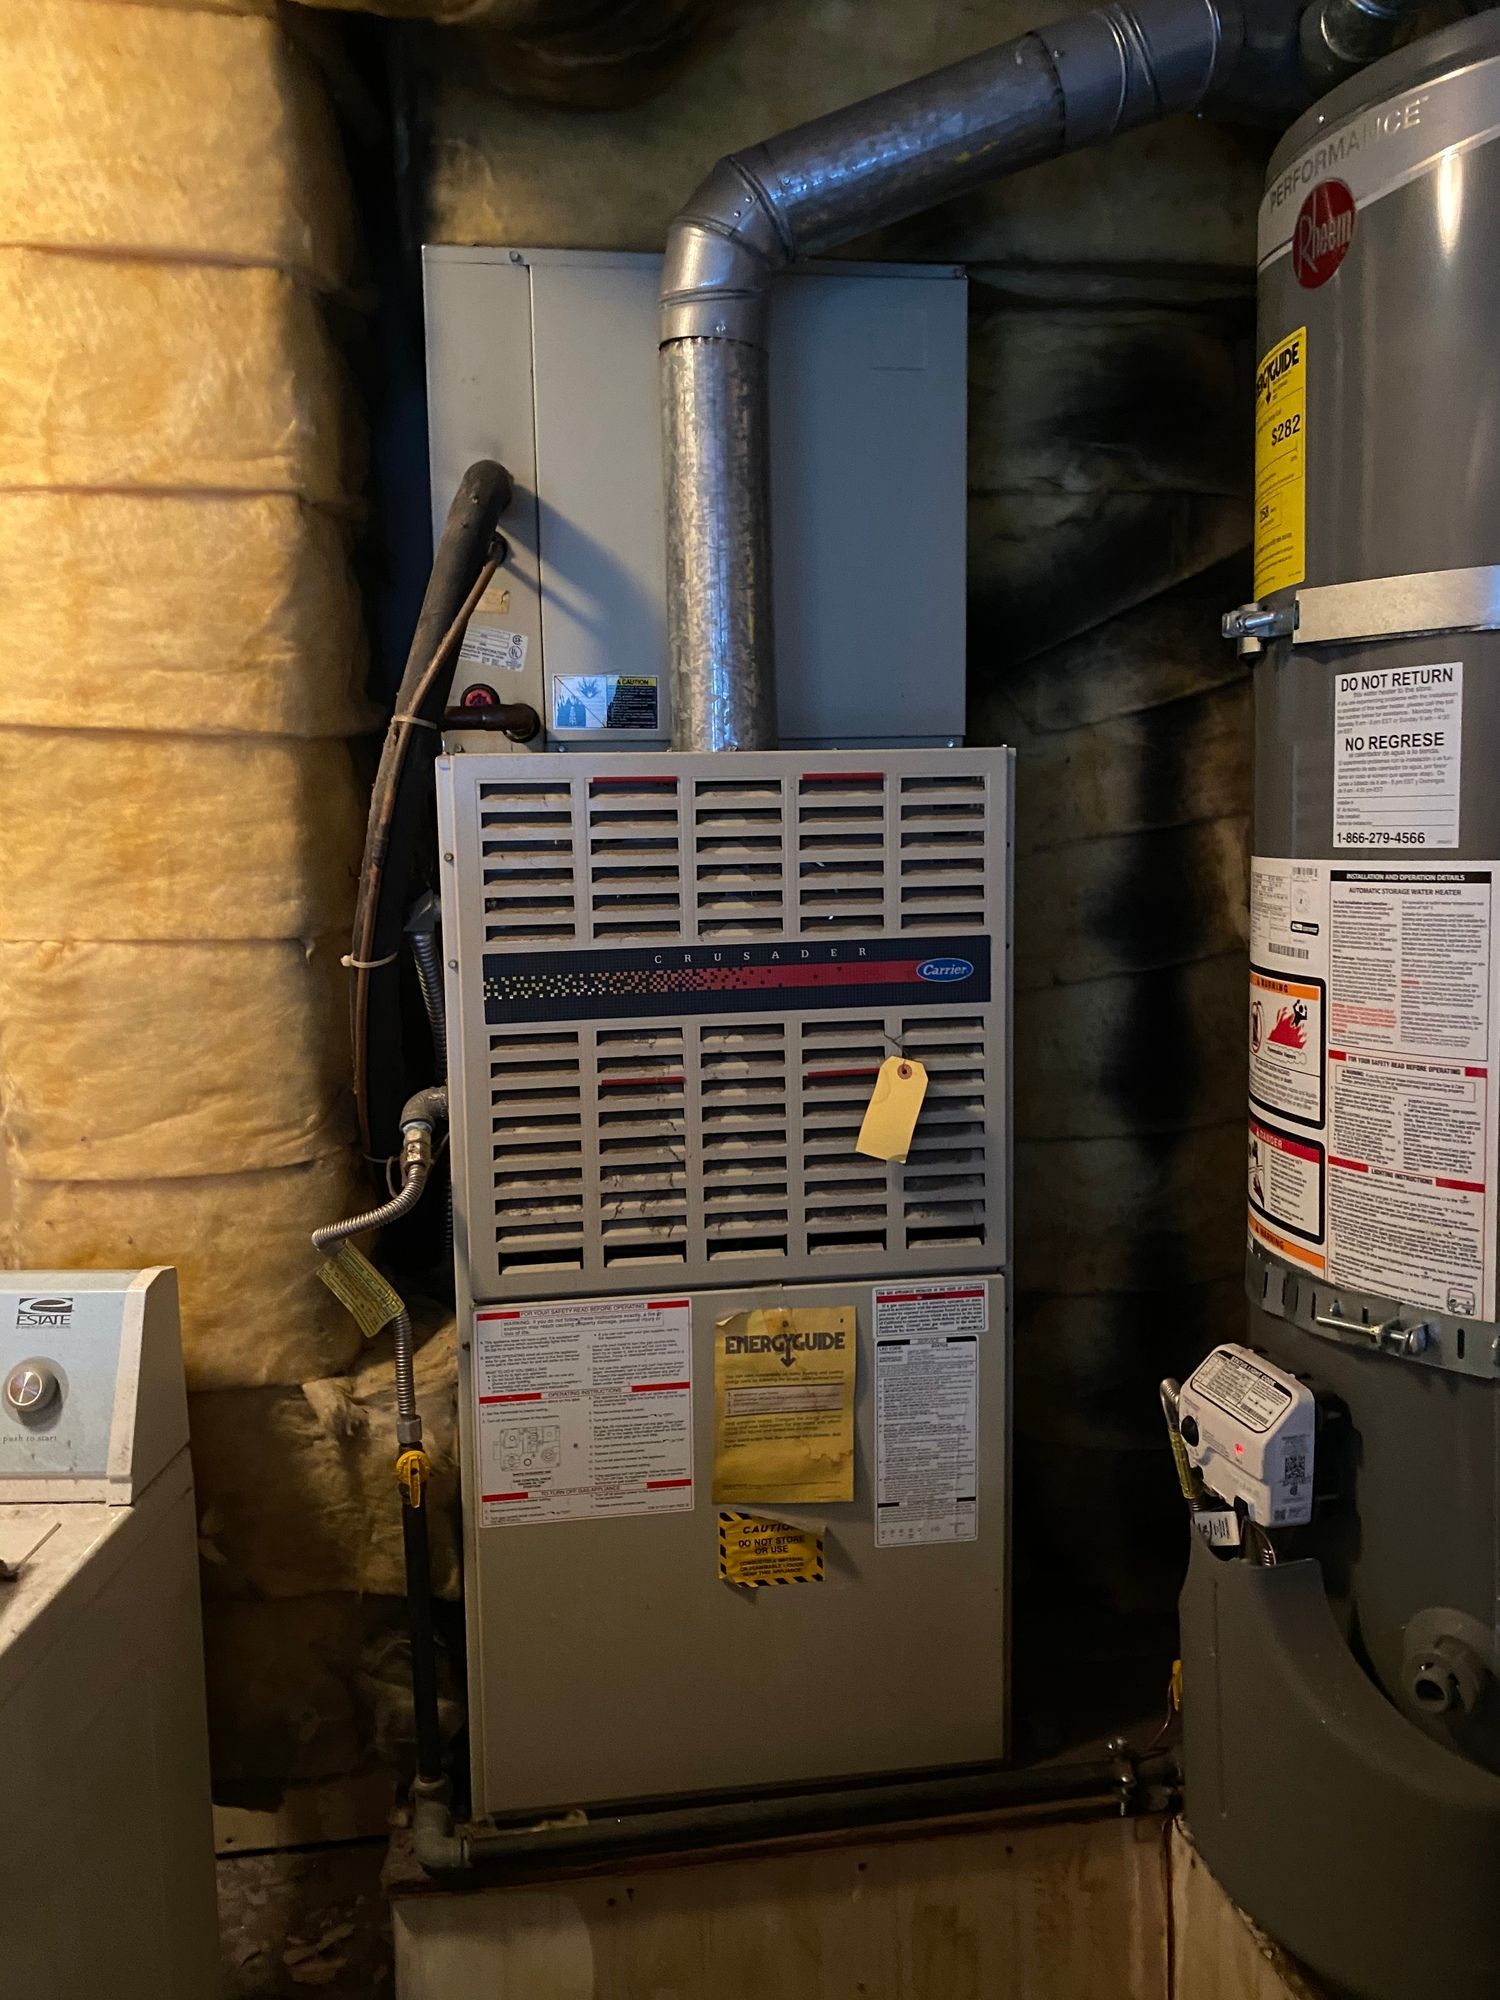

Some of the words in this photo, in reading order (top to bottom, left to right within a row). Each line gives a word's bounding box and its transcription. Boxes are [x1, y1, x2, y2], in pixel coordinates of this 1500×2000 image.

[1298, 190, 1352, 280] Rheem
[1271, 413, 1300, 446] $282
[1341, 677, 1358, 692] DO
[1362, 674, 1388, 690] NOT
[1392, 668, 1453, 687] RETURN
[1345, 737, 1364, 751] NO
[1369, 732, 1444, 750] REGRESE
[1337, 832, 1426, 844] 1-866-279-4566
[654, 947, 867, 965] CRUSADER
[921, 962, 969, 977] Carrier
[1259, 1130, 1283, 1149] DANGER
[16, 1315, 71, 1326] ESTATE
[725, 1332, 845, 1355] ENERGYGUIDE
[2, 1434, 23, 1444] push
[743, 1523, 797, 1534] CAUTIO
[738, 1540, 752, 1548] DO
[754, 1537, 773, 1546] NOT
[754, 1547, 768, 1555] OR
[770, 1545, 788, 1553] USE
